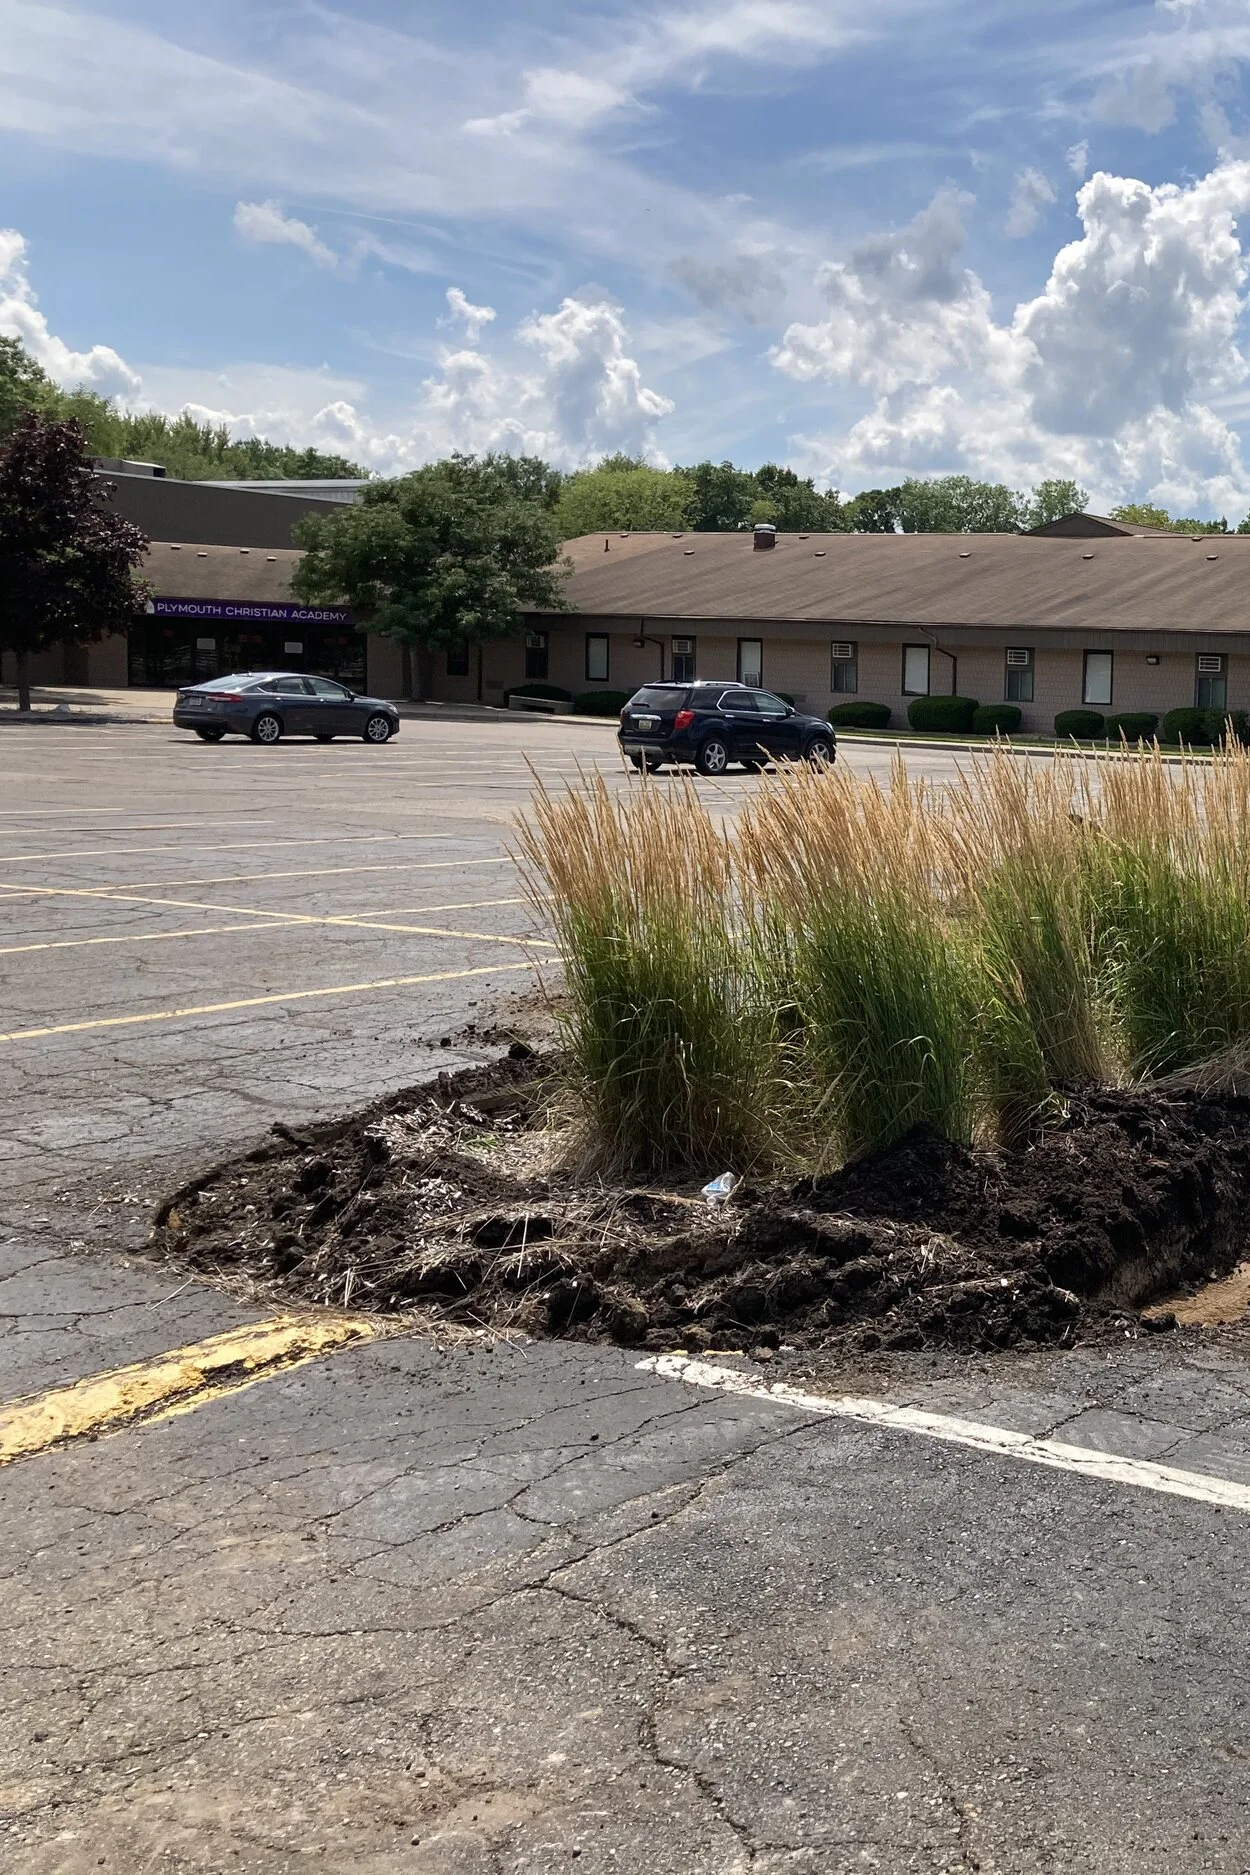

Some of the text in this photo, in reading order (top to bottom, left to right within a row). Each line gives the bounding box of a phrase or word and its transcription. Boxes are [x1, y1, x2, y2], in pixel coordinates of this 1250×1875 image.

[157, 603, 347, 621] PLYMOUTH CHRISTIAN ACADEMY
